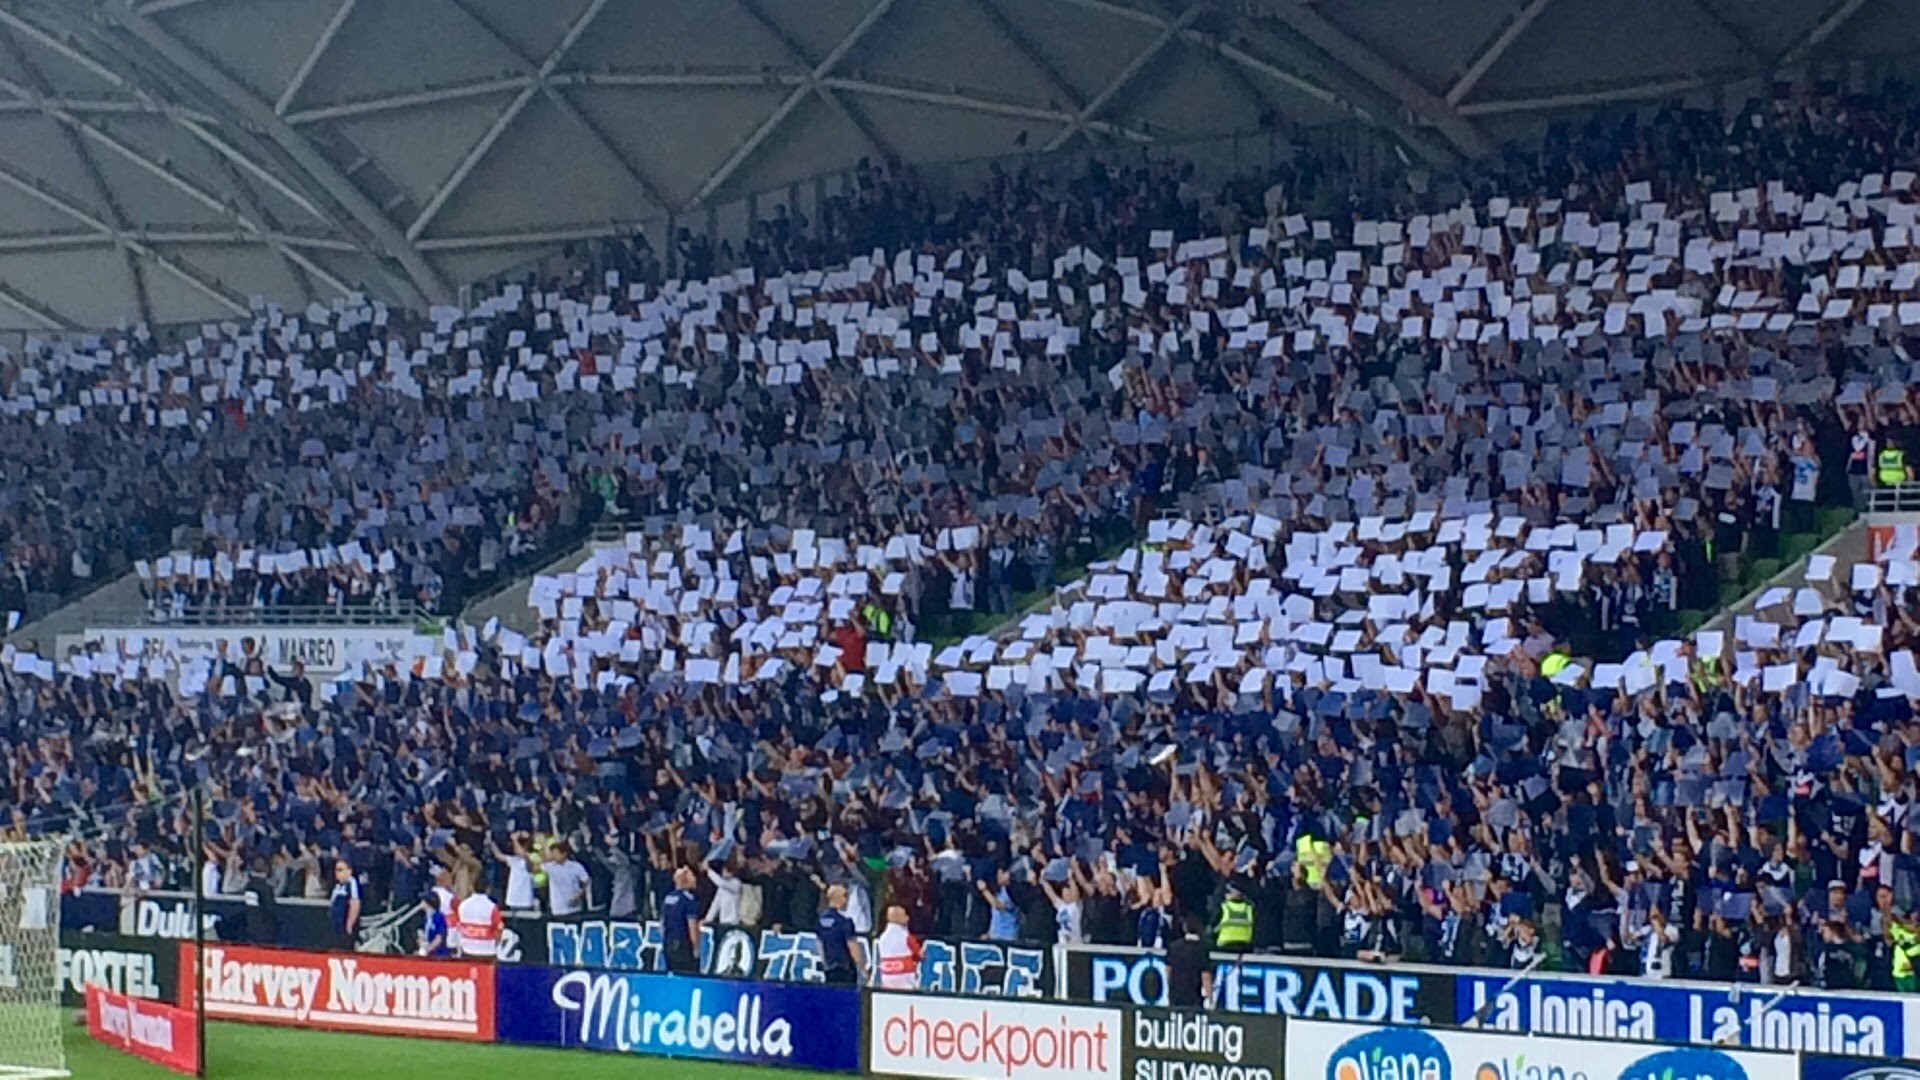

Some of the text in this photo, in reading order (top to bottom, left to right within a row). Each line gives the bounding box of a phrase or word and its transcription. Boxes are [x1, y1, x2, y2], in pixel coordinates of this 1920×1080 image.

[57, 948, 160, 999] FOXTEL
[195, 948, 478, 1021] Harvey Norman
[759, 930, 1043, 998] TEACE
[552, 970, 794, 1057] Mirabella
[883, 1004, 1109, 1078] checkpoint
[1134, 1010, 1244, 1063] building
